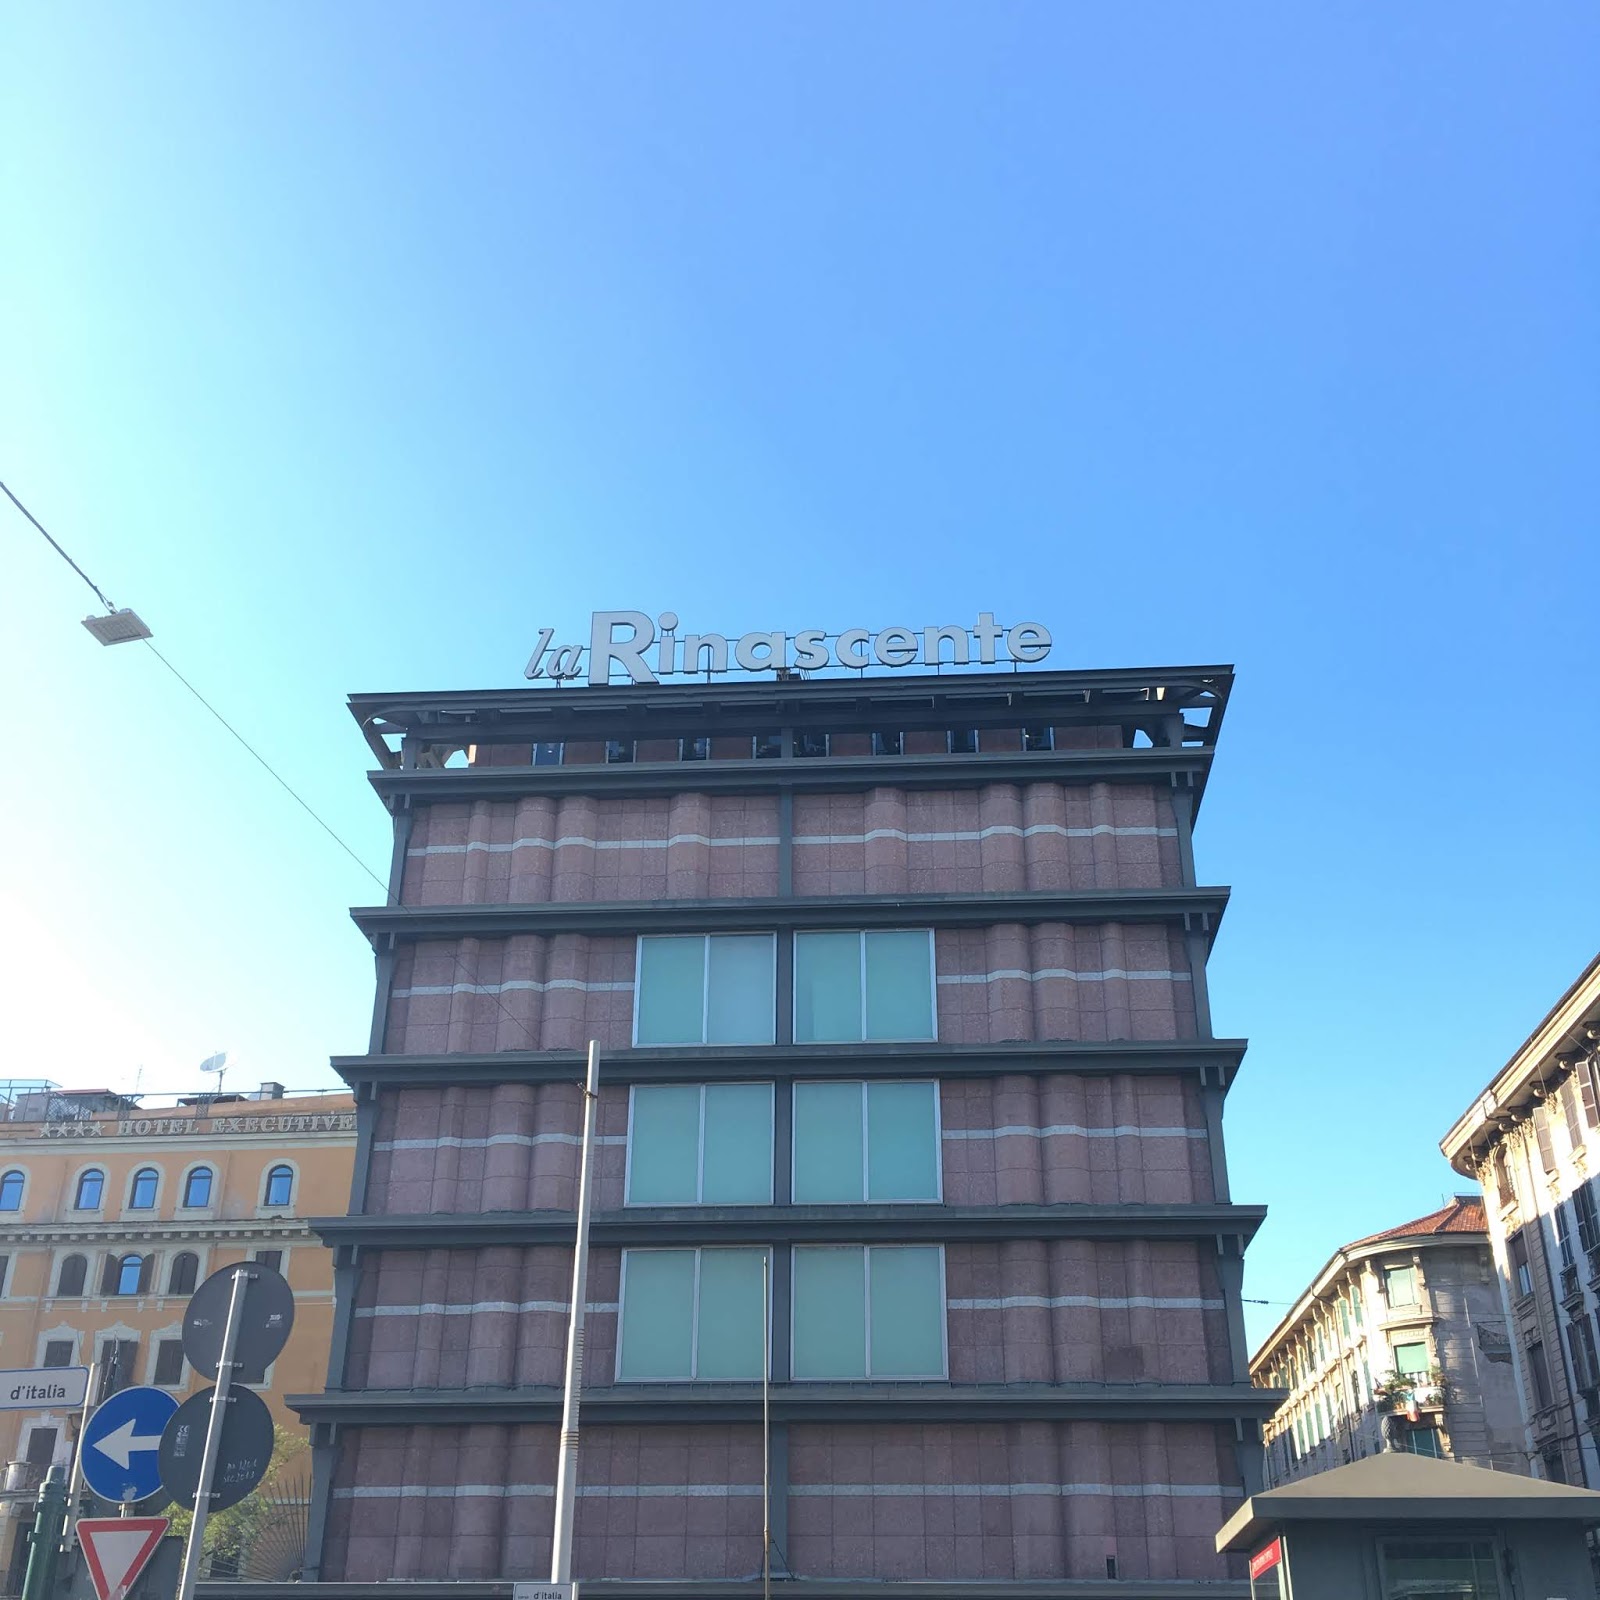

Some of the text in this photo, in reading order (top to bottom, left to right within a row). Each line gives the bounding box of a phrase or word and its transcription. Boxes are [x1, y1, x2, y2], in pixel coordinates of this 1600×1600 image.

[524, 611, 1052, 686] la Rinascente
[117, 1113, 353, 1136] HOTEL EXECUTIVE
[10, 1384, 66, 1400] d'italia
[533, 1591, 562, 1600] d'italia
